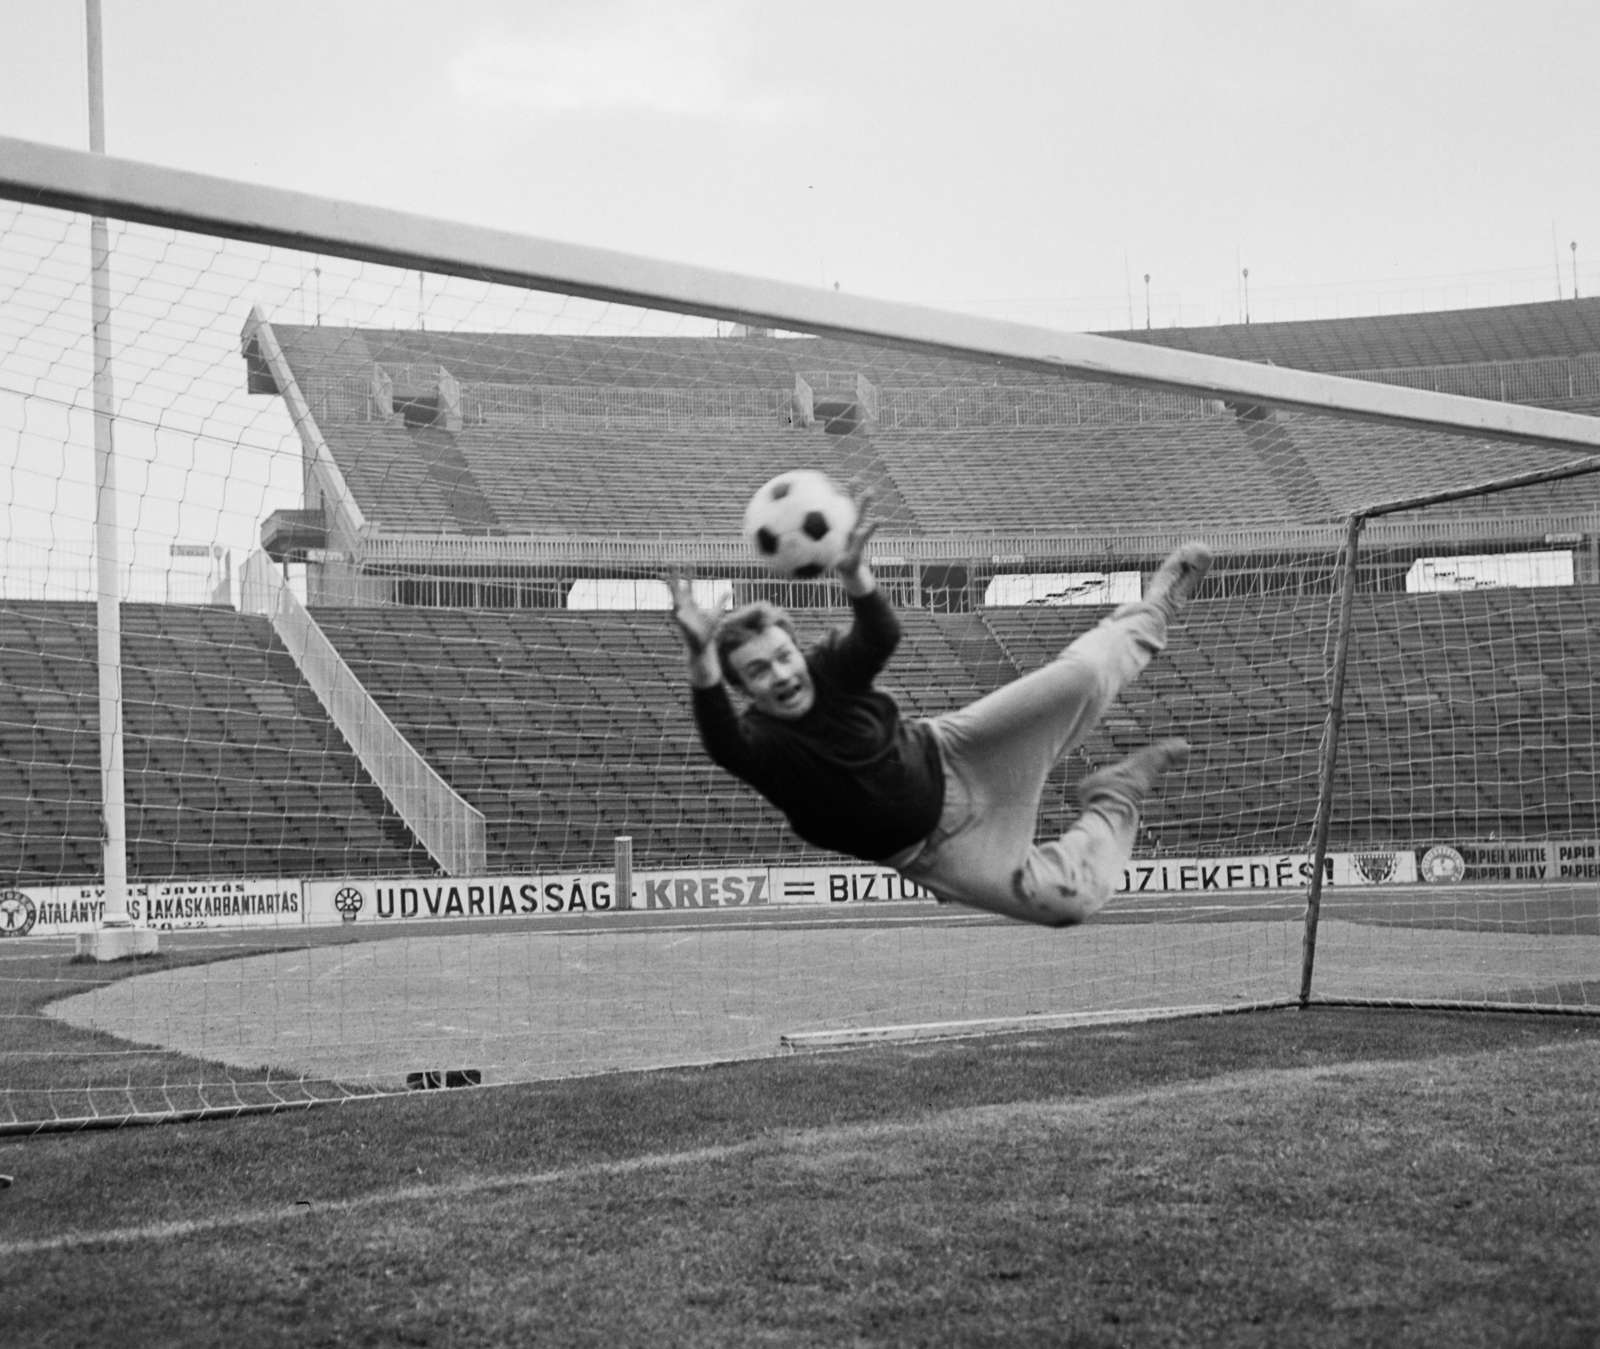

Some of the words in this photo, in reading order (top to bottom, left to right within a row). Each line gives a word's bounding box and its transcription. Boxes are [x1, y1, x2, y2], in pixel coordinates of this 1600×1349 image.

[147, 890, 298, 920] LAKÁSKARBANTARTÁS
[376, 878, 611, 918] UDVARIASSÁG
[645, 875, 769, 909] KRESZ
[829, 874, 928, 902] BIZTO
